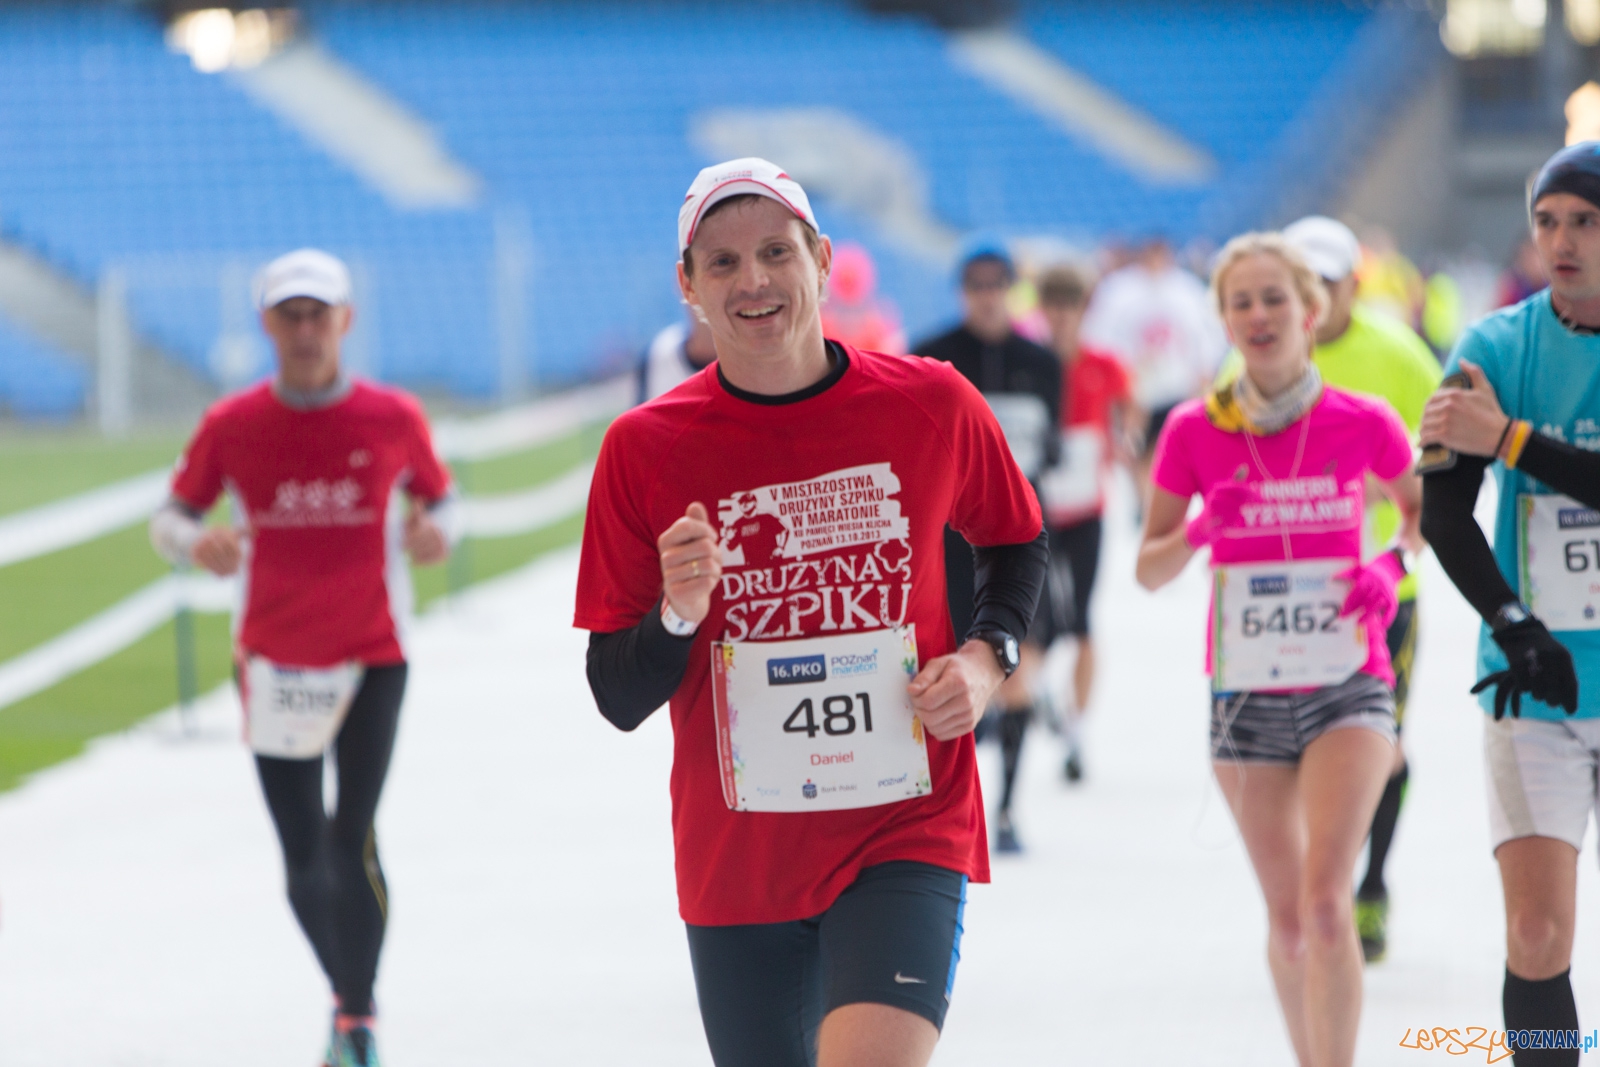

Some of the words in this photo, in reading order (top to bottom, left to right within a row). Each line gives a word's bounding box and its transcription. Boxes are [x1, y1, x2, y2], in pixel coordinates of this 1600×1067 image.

[769, 488, 778, 502] V
[782, 474, 875, 500] MISTRZOSTWA
[779, 493, 836, 516] DRUŻYNY
[840, 487, 885, 507] SZPIKU
[791, 514, 804, 529] W
[807, 503, 880, 526] MARATONIE
[1239, 496, 1355, 527] YZWANIE
[835, 529, 882, 546] 13.10.2013
[721, 553, 884, 601] DRUŻYNA
[724, 582, 913, 643] SZPIKU
[1241, 601, 1341, 638] 6462
[791, 661, 823, 678] PKO
[831, 661, 878, 676] maraton
[782, 691, 873, 739] 481
[810, 750, 855, 767] Daniel
